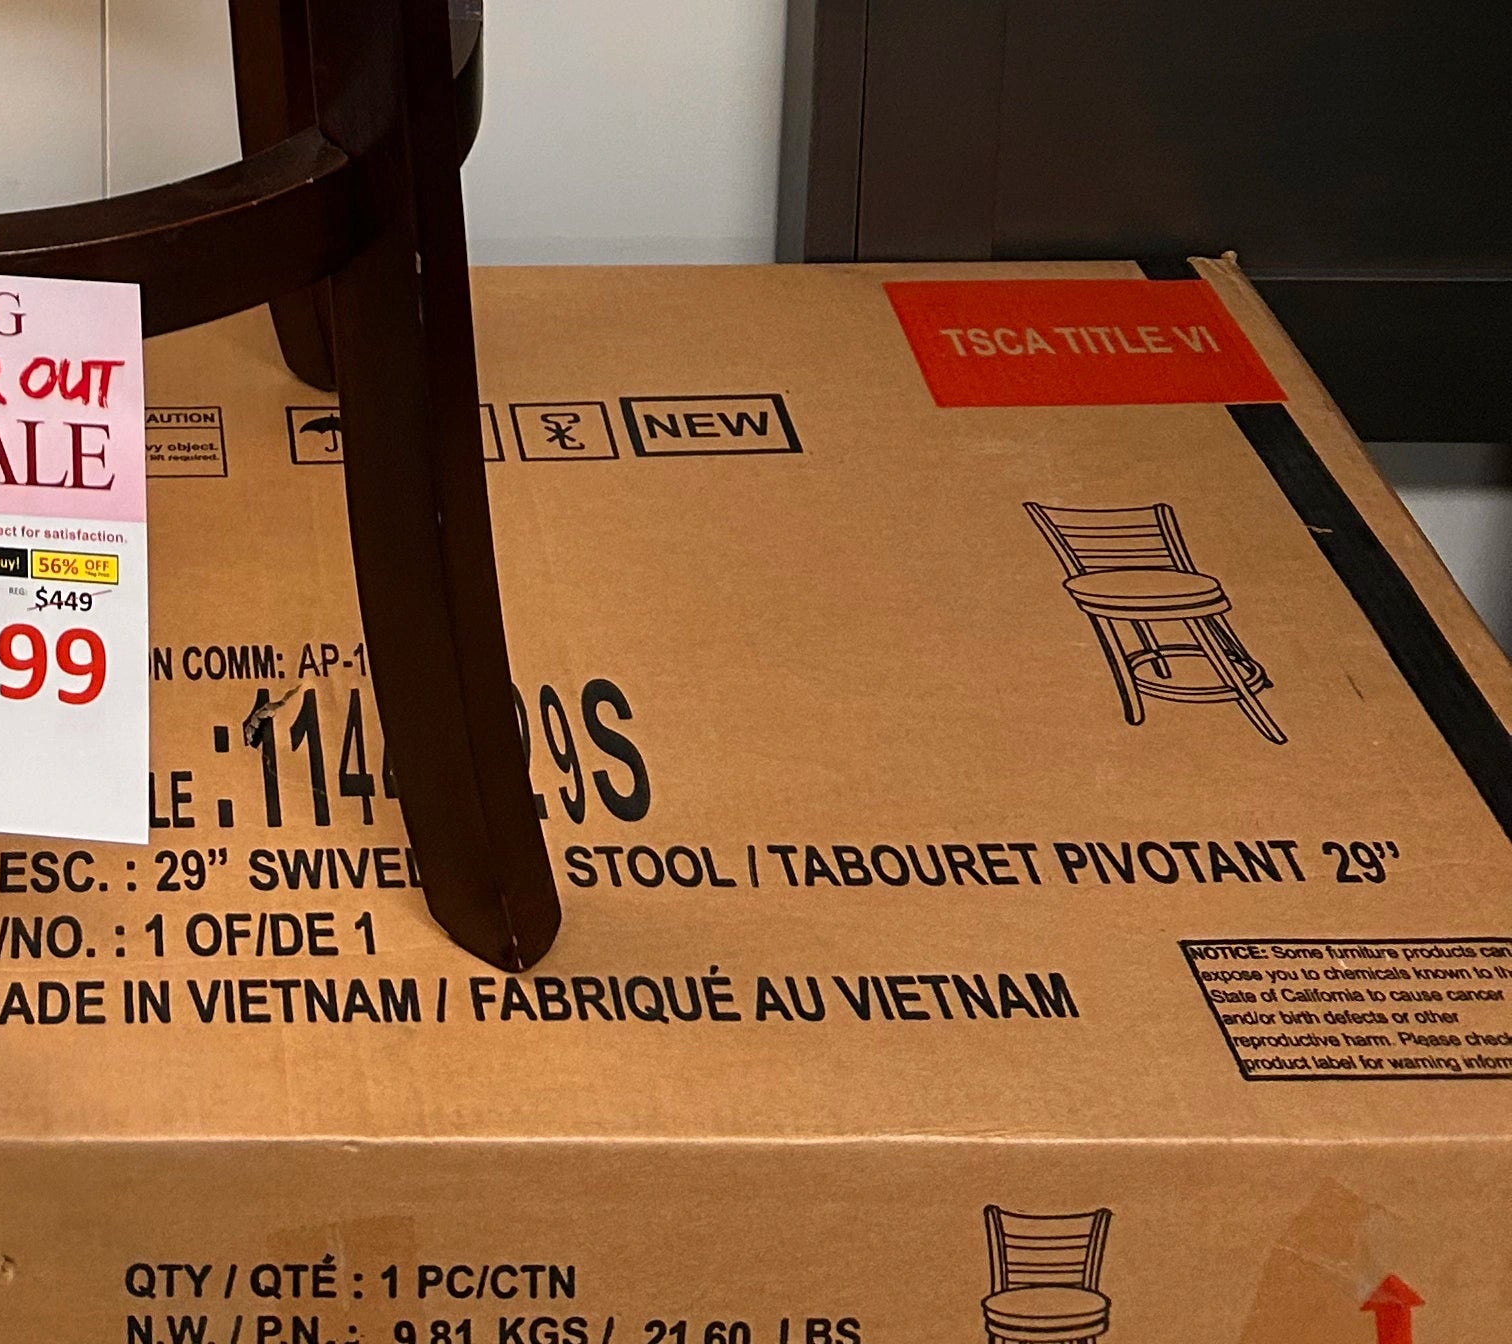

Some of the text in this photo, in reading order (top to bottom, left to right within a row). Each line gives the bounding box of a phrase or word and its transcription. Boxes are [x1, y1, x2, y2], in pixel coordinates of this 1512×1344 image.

[940, 324, 1221, 357] TSCA TITLE VI
[19, 357, 126, 409] OUT
[146, 413, 215, 424] AUTION
[643, 410, 769, 440] NEW
[168, 442, 219, 453] object.
[21, 525, 40, 538] for
[43, 528, 128, 544] satisfaction.
[38, 557, 109, 576] 56% OFF
[35, 586, 93, 612] $449
[187, 645, 285, 680] COMM:
[566, 845, 737, 888] STOOL
[767, 842, 1043, 886] TABOURET
[1054, 840, 1309, 884] PIVOTANT
[146, 915, 165, 957] 1
[186, 912, 339, 957] OF/DE
[357, 912, 376, 955] 1
[1188, 946, 1268, 960] NOTICE:
[1271, 945, 1323, 959] Some
[1326, 945, 1398, 959] furniture
[1402, 944, 1477, 961] products
[1201, 966, 1492, 985] expose you to chemicals known to
[124, 979, 171, 1023] IN
[188, 976, 421, 1023] VIETNAM
[435, 976, 447, 1022] /
[470, 964, 739, 1025] FABRIQUÉ
[753, 976, 827, 1022] AU
[833, 972, 1080, 1022] VIETNAM
[1210, 988, 1505, 1003] State of California to cause cancer
[1222, 1010, 1459, 1025] and/or birth defects or other
[1233, 1032, 1341, 1048] reproductive
[1398, 1031, 1462, 1047] Please
[1243, 1055, 1462, 1073] product label for warning
[125, 1263, 213, 1301] QTY
[225, 1263, 237, 1301] /
[249, 1254, 337, 1300] QTÉ
[381, 1265, 398, 1299] 1
[417, 1263, 577, 1301] PC/CTN
